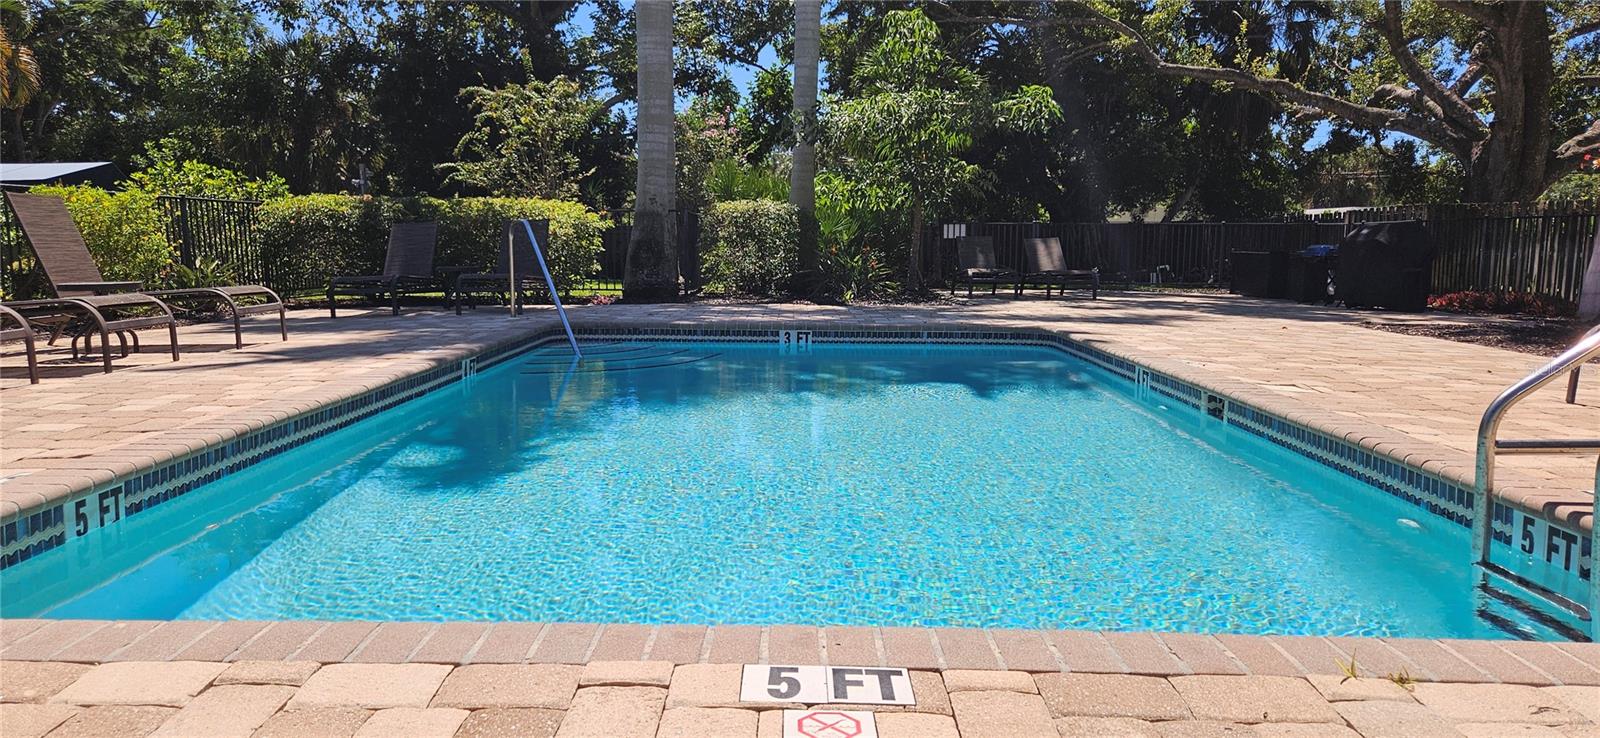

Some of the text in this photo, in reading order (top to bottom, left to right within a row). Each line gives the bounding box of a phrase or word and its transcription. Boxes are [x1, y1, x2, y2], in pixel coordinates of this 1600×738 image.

[784, 331, 811, 344] 3 FT
[75, 485, 123, 537] 5 FT
[1521, 515, 1578, 572] 5 FT
[767, 666, 903, 701] 5 FT
